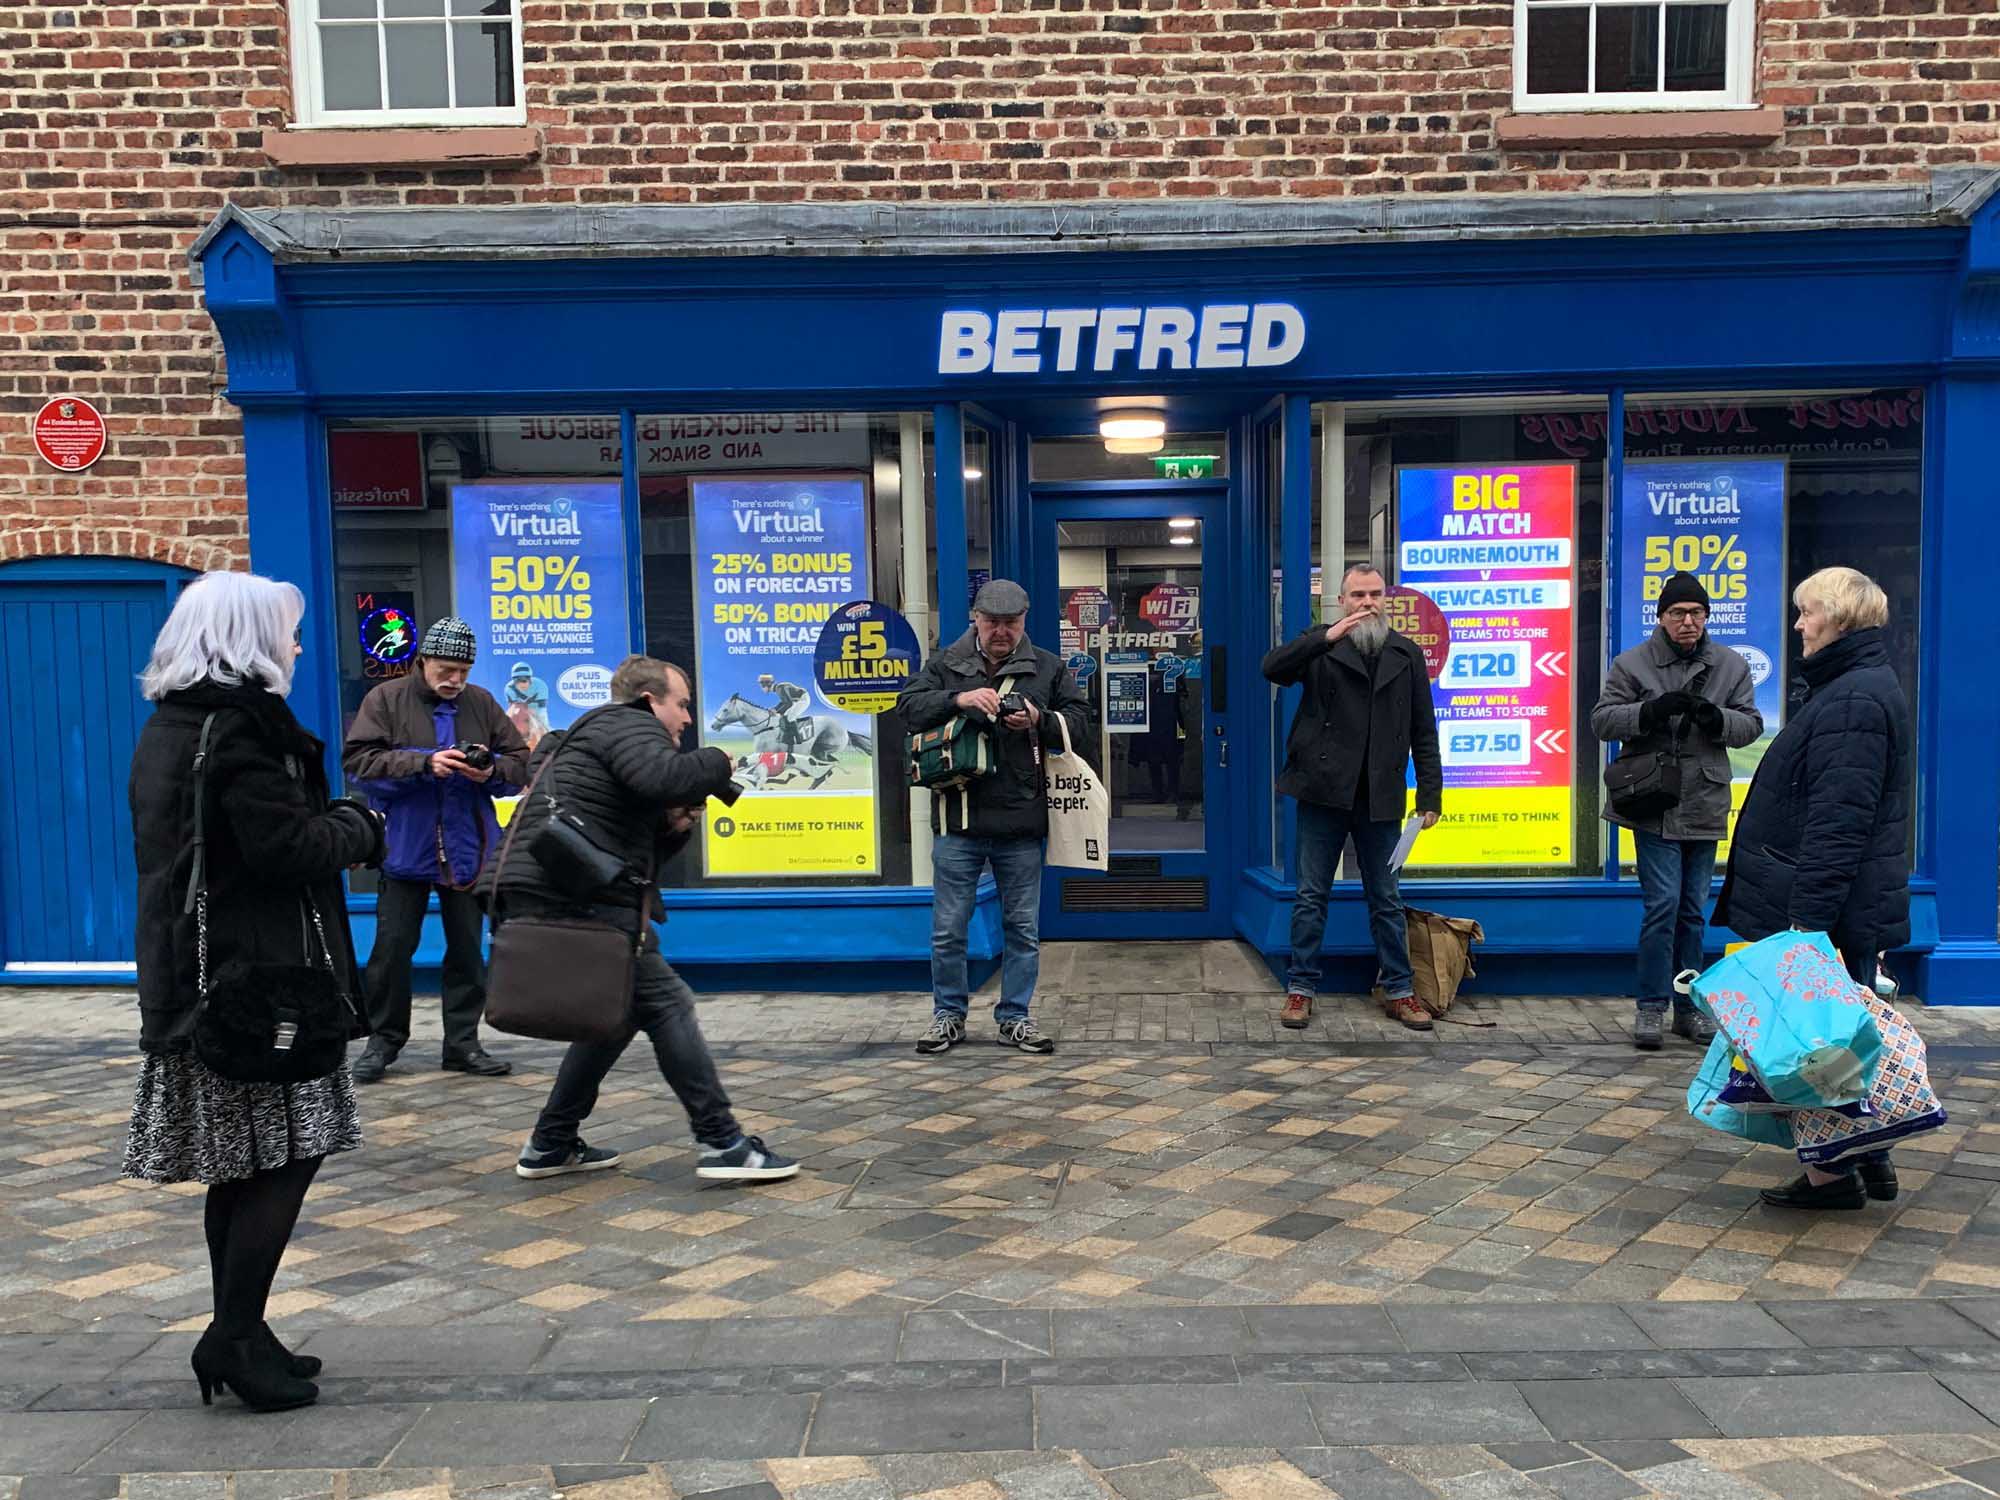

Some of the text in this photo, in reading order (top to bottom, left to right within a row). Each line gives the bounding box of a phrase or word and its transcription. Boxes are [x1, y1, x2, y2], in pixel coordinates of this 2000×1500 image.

[938, 303, 1306, 374] BETFRED
[1453, 474, 1520, 511] BIG
[1647, 480, 1711, 491] There's nothing
[488, 503, 551, 513] There's nothing
[732, 500, 794, 509] There's nothing
[1648, 489, 1740, 515] Virtual
[490, 511, 581, 536] Virtual
[733, 508, 824, 532] Virtual
[1442, 512, 1531, 537] MATCH
[1674, 516, 1700, 525] about
[1710, 516, 1740, 525] winner
[517, 538, 542, 546] about
[552, 538, 581, 546] winner
[760, 535, 785, 543] about
[795, 535, 824, 543] winner
[1407, 545, 1559, 565] BOURNEMOUTH
[1645, 534, 1747, 572] 50%
[711, 553, 852, 574] 25% BONUS
[490, 555, 590, 592] 50%
[714, 576, 852, 593] ON FORECASTS
[1643, 574, 1747, 600] BUS
[490, 594, 592, 620] BONUS
[1384, 596, 1418, 614] EST
[1642, 603, 1747, 614] ON ORRECT
[714, 603, 769, 624] 50%
[774, 603, 839, 623] BONU
[492, 622, 592, 633] ON AN ALL CORRECT
[836, 623, 856, 632] WIN
[1450, 617, 1520, 628] HOME WIN &
[492, 633, 593, 644] LUCKY 15/YANKEE
[725, 627, 823, 643] ON TRICAS
[841, 621, 887, 660] £5
[1088, 632, 1173, 648] BETFRED
[1455, 629, 1493, 640] TEAMS
[1496, 629, 1510, 638] TO
[1513, 628, 1549, 638] SCORE
[728, 646, 815, 655] ONE MEETING EVER
[824, 659, 909, 680] MILLION
[1451, 653, 1515, 677] £120
[576, 672, 600, 680] PLUS
[562, 682, 611, 690] DAILY PRIC
[571, 692, 607, 700] BOOSTS
[1450, 695, 1482, 706] AWAY
[1486, 695, 1508, 705] WIN
[1434, 706, 1549, 718] TH TEAMS TO SCORE
[800, 725, 813, 740] 17
[1450, 734, 1521, 753] £37.50
[770, 754, 778, 766] 1
[1055, 773, 1092, 793] bag's
[1047, 796, 1089, 814] eeper.
[1440, 812, 1560, 823] AKE TIME TO THINK
[740, 821, 864, 831] TAKE TIME TO THINK
